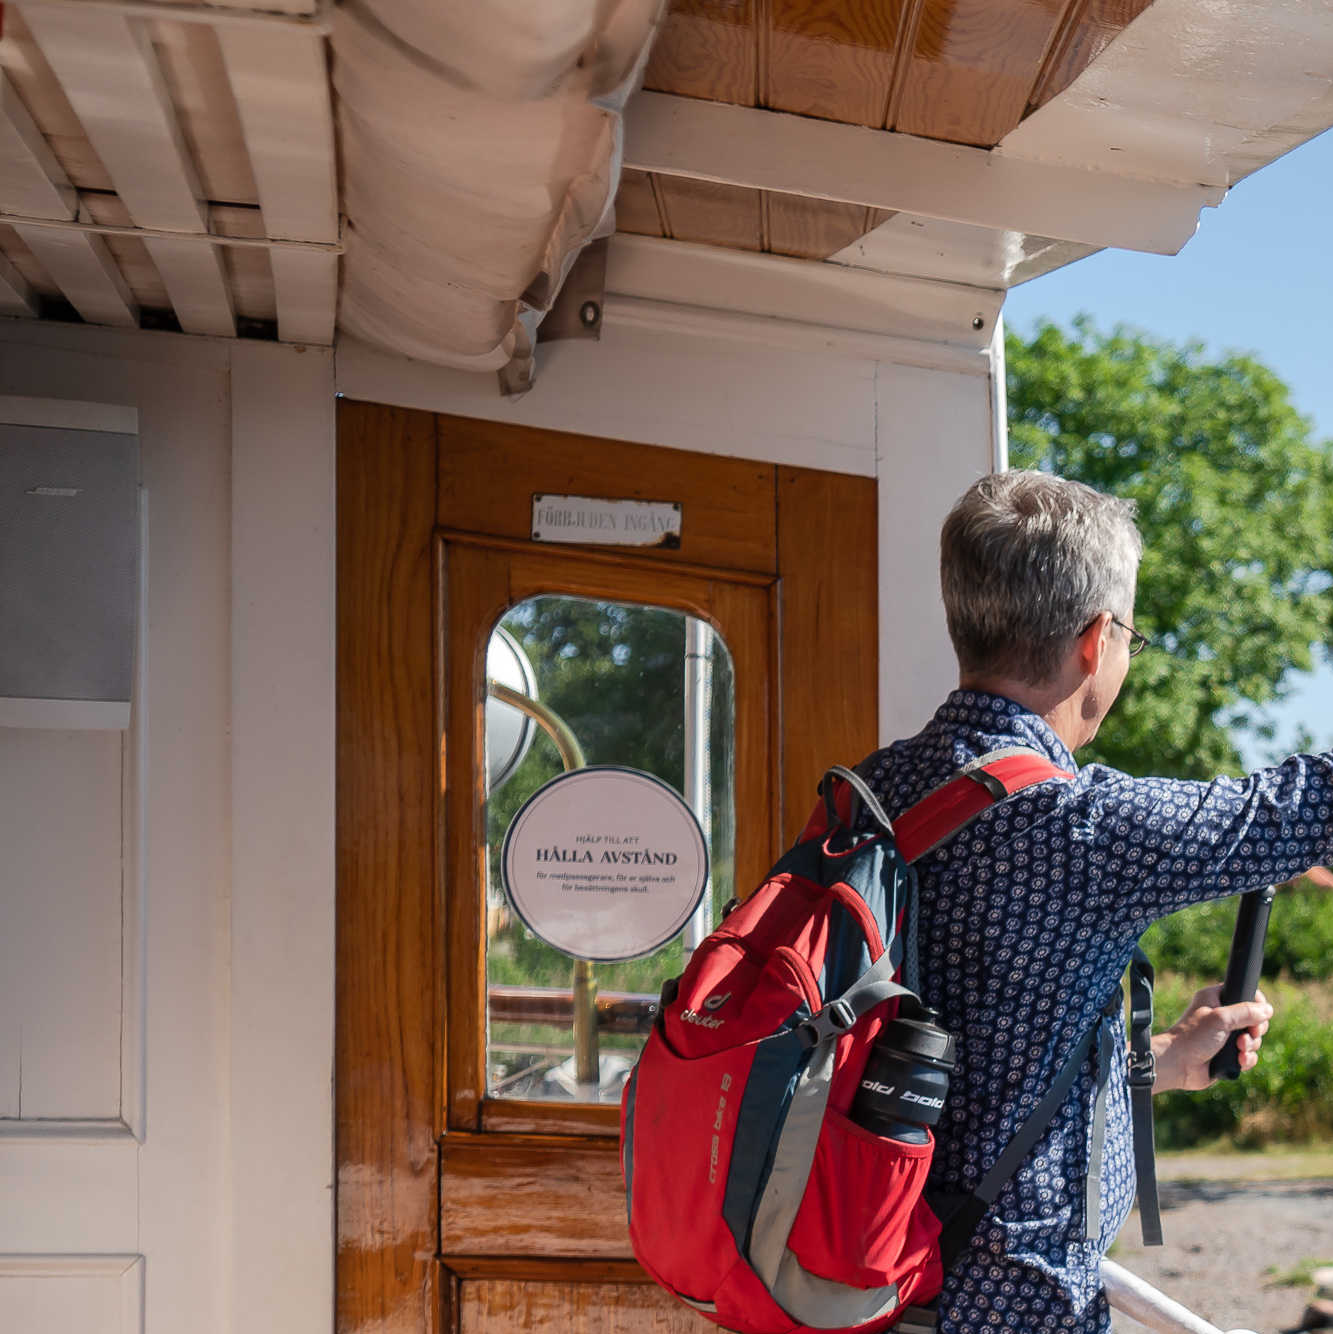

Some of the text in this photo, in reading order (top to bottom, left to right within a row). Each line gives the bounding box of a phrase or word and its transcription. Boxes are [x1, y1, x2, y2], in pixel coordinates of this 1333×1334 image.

[537, 505, 617, 530] FÖRBJUDEN
[602, 836, 621, 844] TILL
[623, 836, 640, 844] ATT
[536, 845, 678, 865] HÅLLA AVSTÅND
[536, 871, 547, 879] för
[616, 873, 627, 881] för
[638, 874, 660, 884] själva
[662, 874, 676, 883] och
[562, 883, 573, 891] för
[680, 1008, 725, 1029] deuter
[900, 1090, 945, 1109] bold
[709, 1073, 732, 1184] cross bike 18
